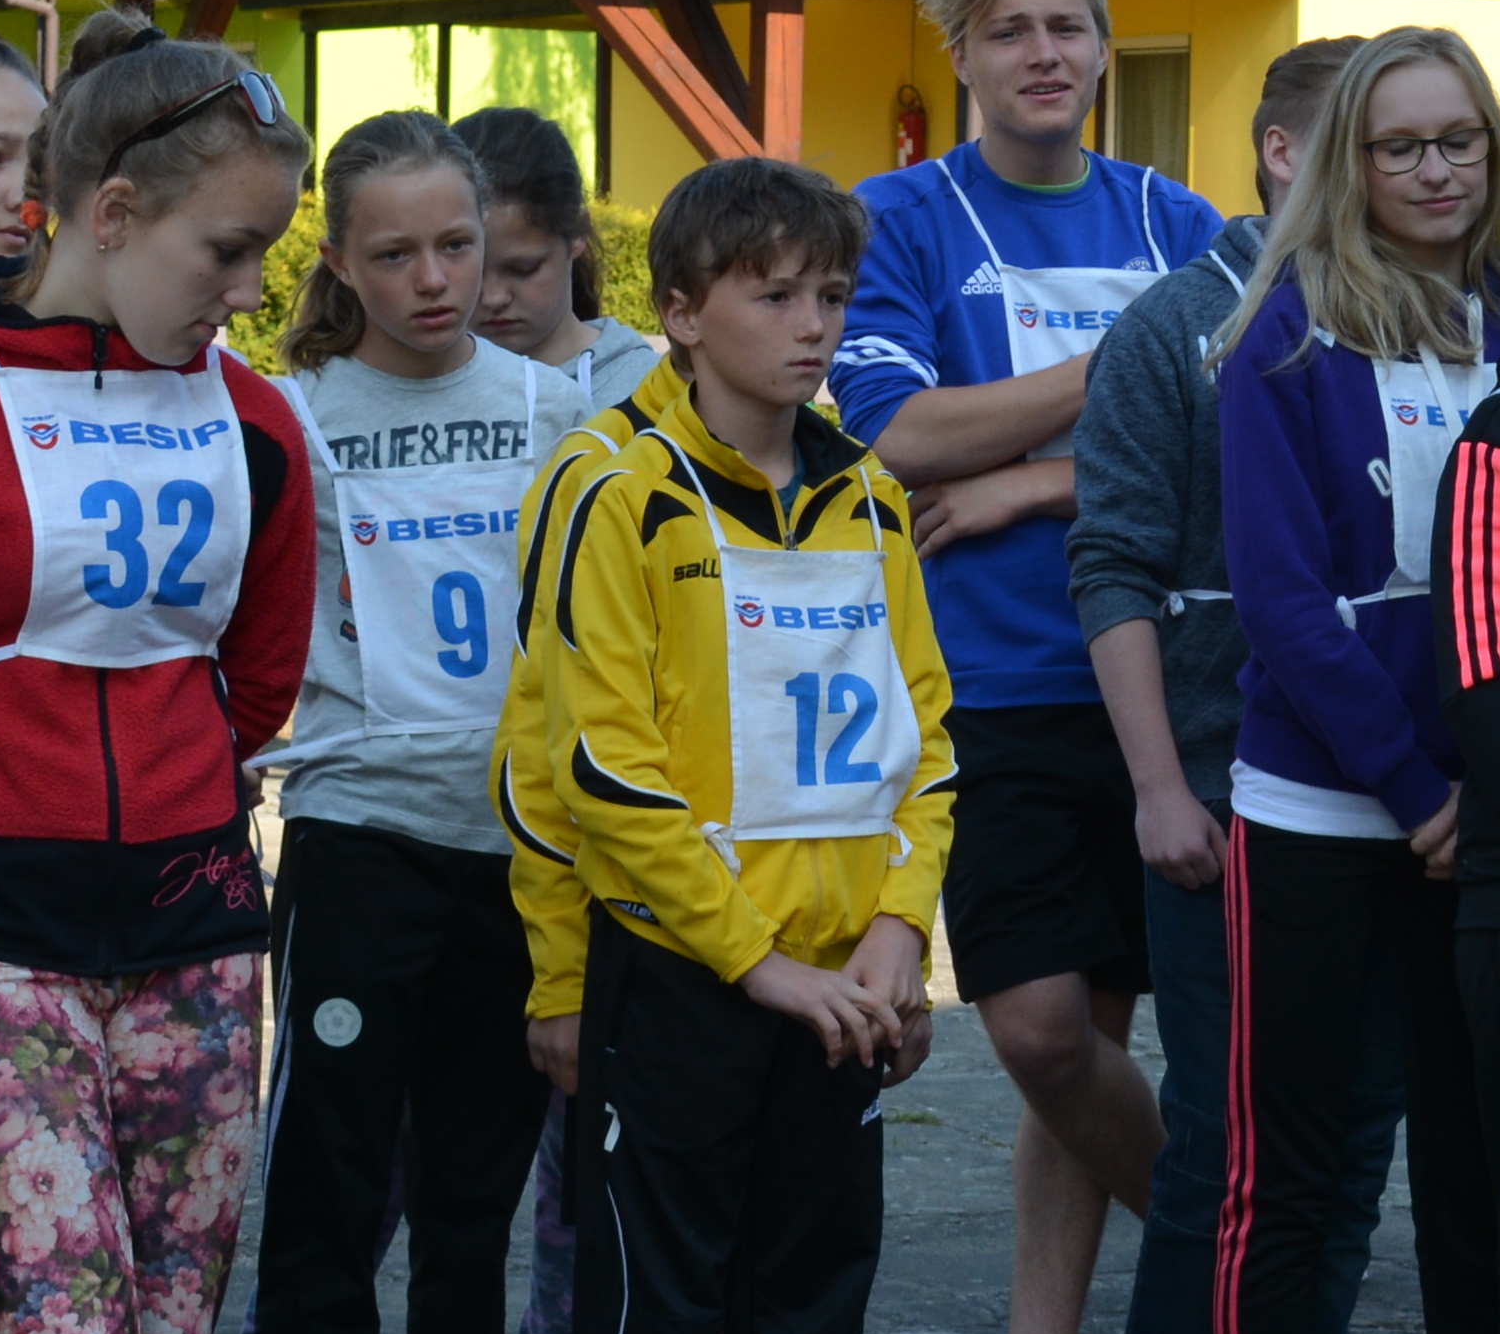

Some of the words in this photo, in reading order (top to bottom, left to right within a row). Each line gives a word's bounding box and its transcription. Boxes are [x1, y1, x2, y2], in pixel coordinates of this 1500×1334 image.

[1045, 309, 1121, 330] BES
[69, 419, 229, 451] BESIP
[80, 479, 215, 609] 32
[673, 558, 720, 582] sall
[432, 571, 489, 678] 9
[785, 672, 882, 787] 12
